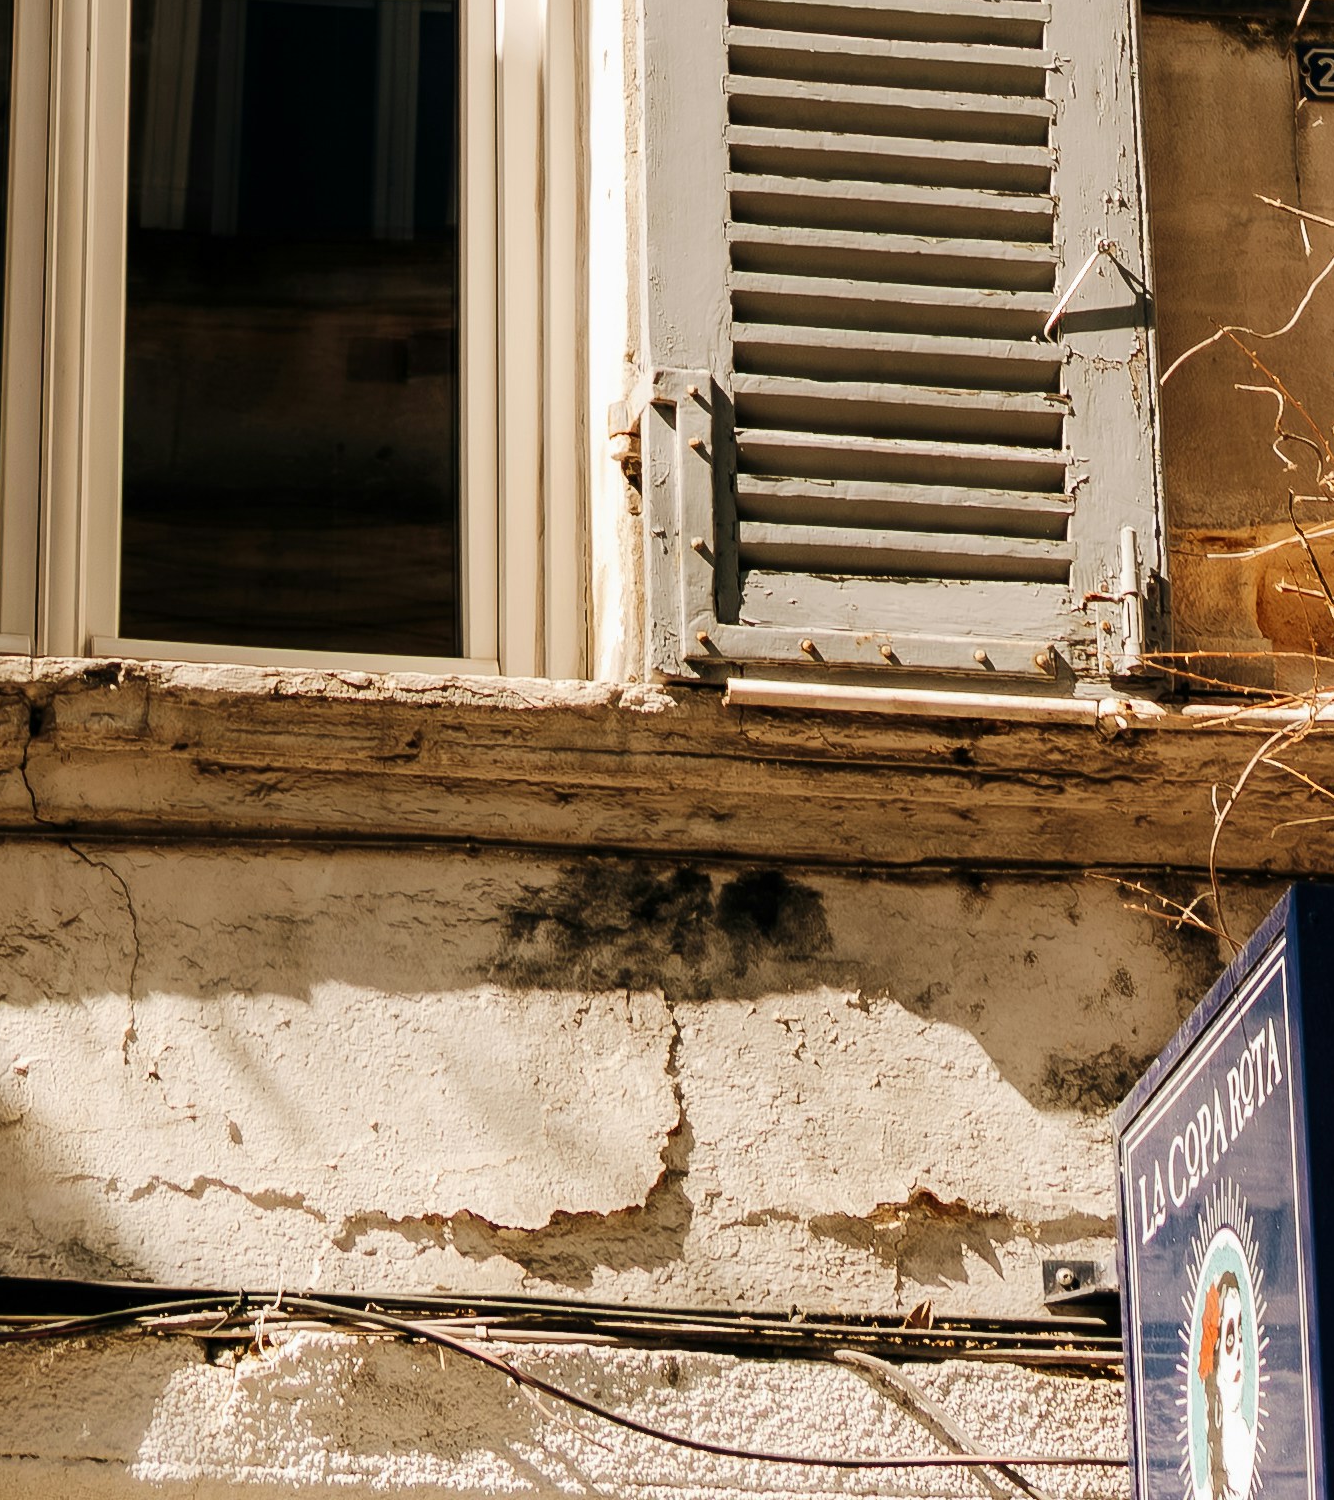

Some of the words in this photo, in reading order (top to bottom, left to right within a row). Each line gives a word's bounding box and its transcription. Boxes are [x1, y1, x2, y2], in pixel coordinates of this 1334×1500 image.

[1139, 1159, 1166, 1245] LA
[1168, 1087, 1229, 1208] COPA
[1227, 1017, 1283, 1142] ROTA
